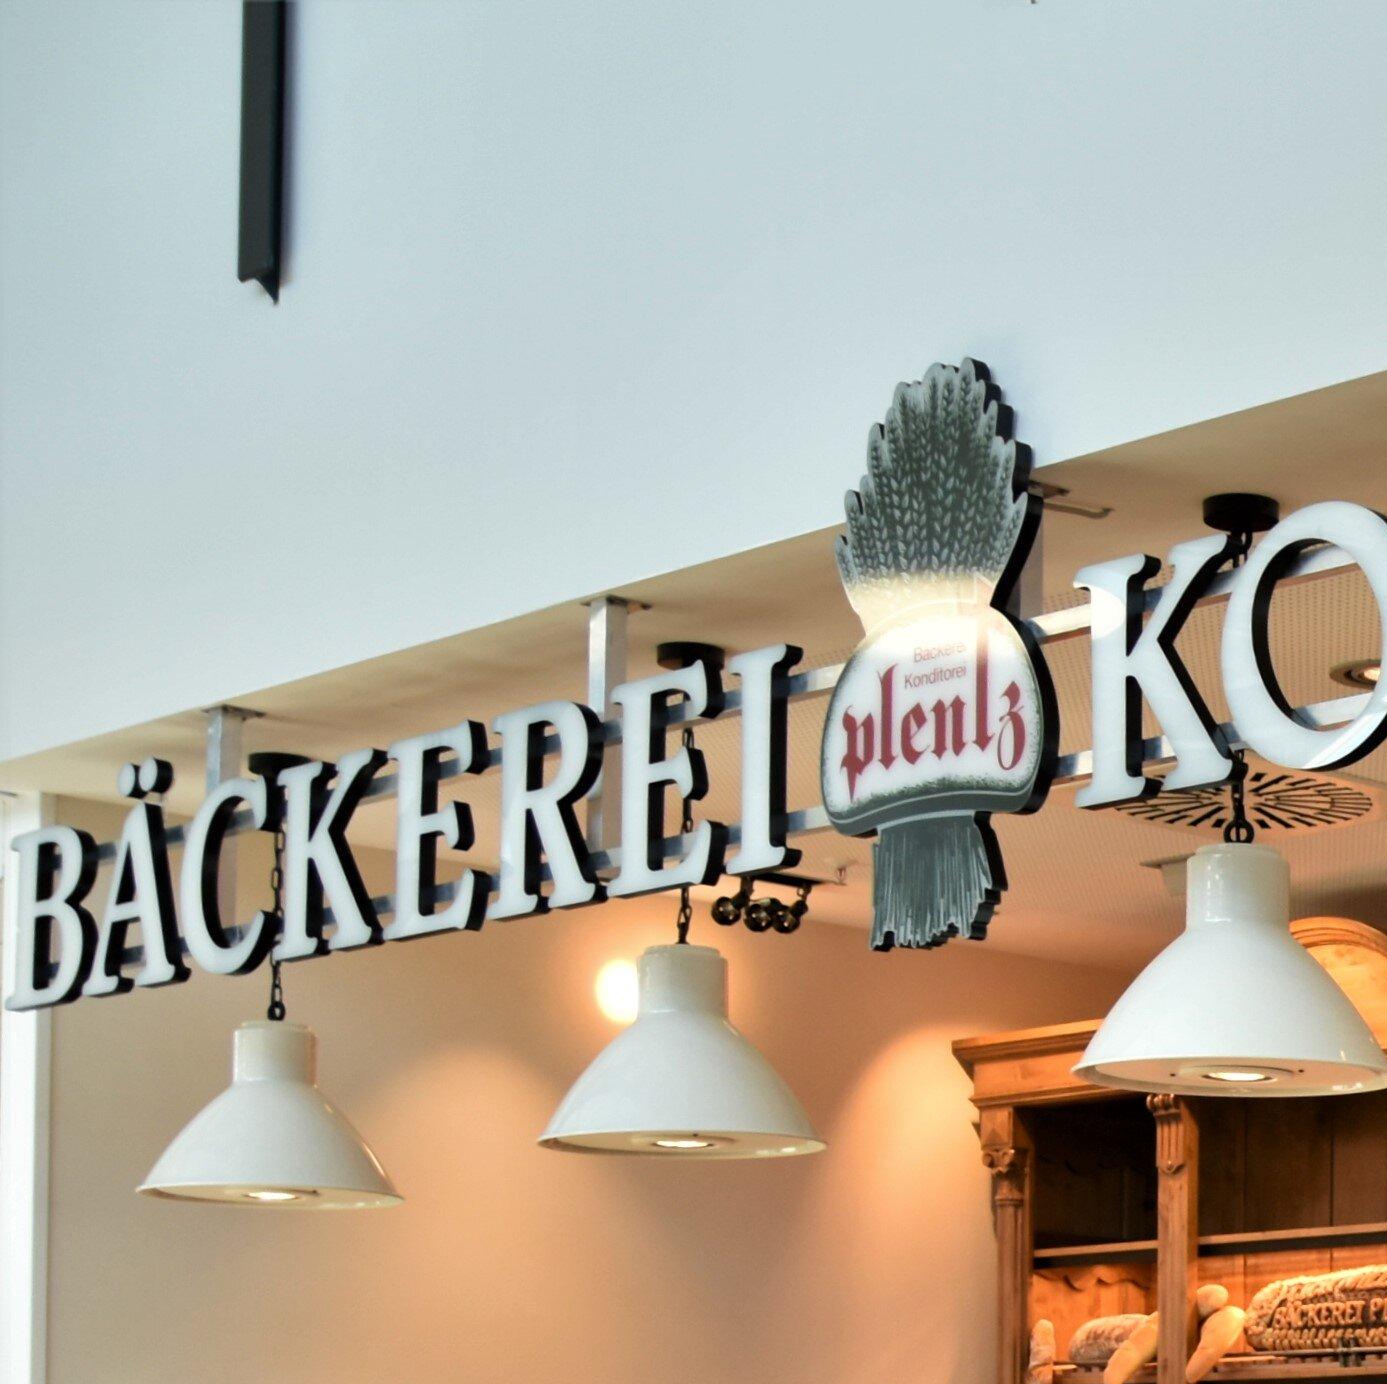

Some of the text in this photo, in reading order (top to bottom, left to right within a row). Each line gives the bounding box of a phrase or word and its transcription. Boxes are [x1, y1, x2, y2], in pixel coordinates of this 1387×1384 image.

[840, 622, 1025, 801] plentz
[904, 664, 967, 689] Konditorei
[8, 643, 803, 1010] BÄCKEREI
